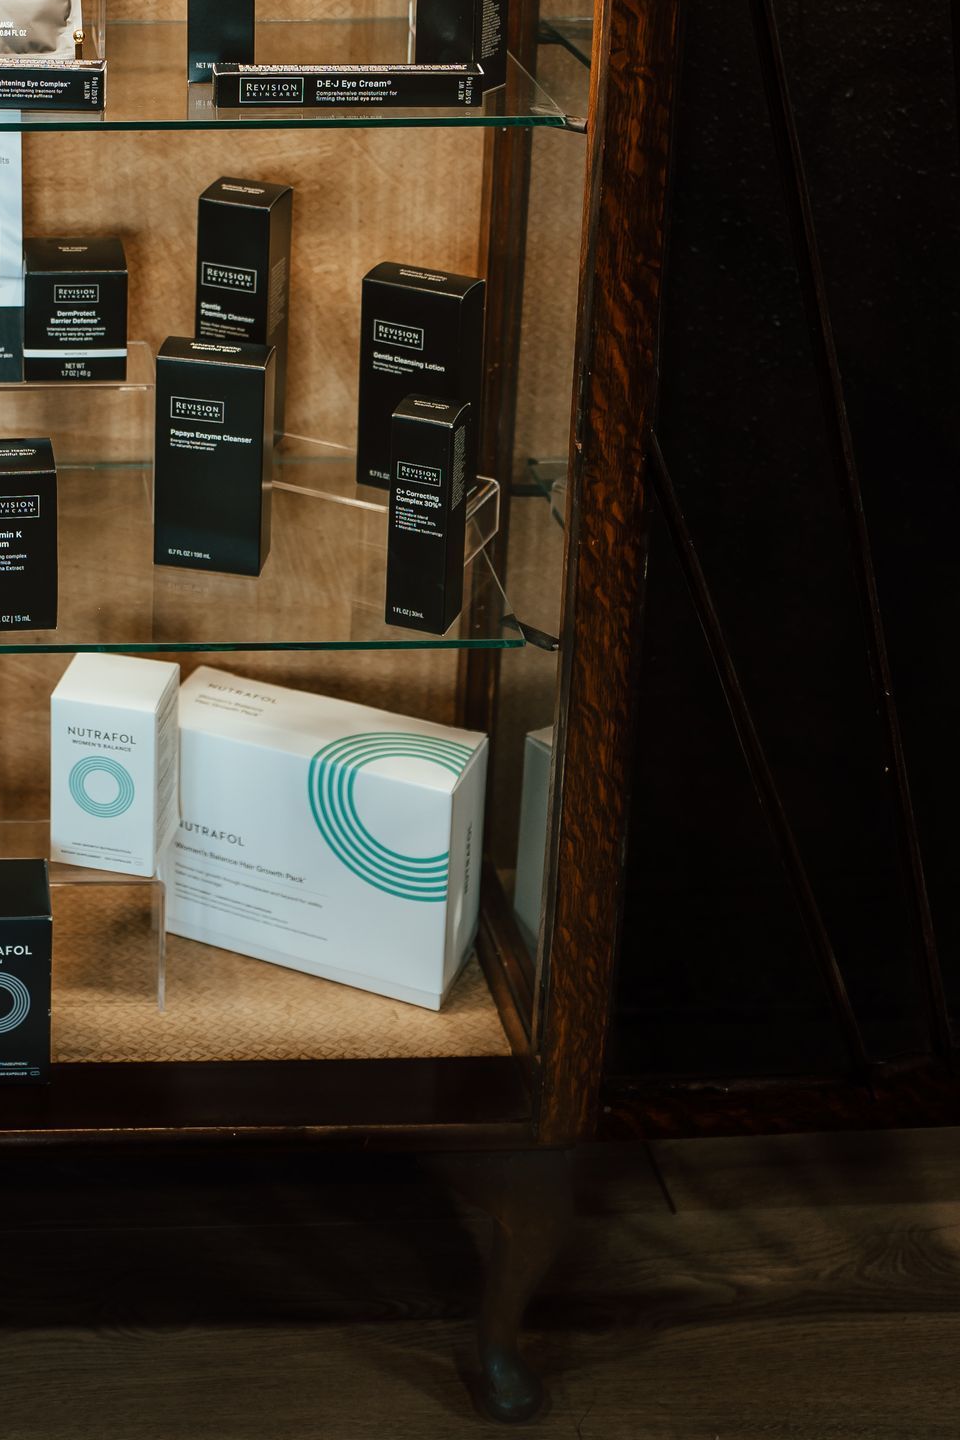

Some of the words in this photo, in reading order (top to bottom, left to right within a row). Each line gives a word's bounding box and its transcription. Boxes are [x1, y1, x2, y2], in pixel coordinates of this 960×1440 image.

[26, 80, 39, 88] Eye
[247, 83, 297, 91] REVISION
[341, 80, 357, 88] Eye
[207, 268, 252, 281] REVISION
[201, 302, 221, 310] Gentle
[201, 310, 227, 320] Foaming
[228, 314, 255, 323] Cleanser
[379, 325, 419, 339] REVISION
[373, 352, 393, 361] Gentle
[394, 356, 424, 369] Cleansing
[425, 362, 446, 372] Lotion
[176, 402, 219, 413] REVISION
[170, 429, 195, 438] Papaya
[196, 432, 221, 441] Enzyme
[223, 434, 252, 444] Cleanser
[401, 466, 437, 478] REVISION
[396, 495, 423, 506] Complex
[406, 490, 440, 502] Correcting
[67, 726, 136, 745] NUTRAFOL
[72, 739, 102, 748] WOMEN'S
[103, 744, 132, 752] BALANCE
